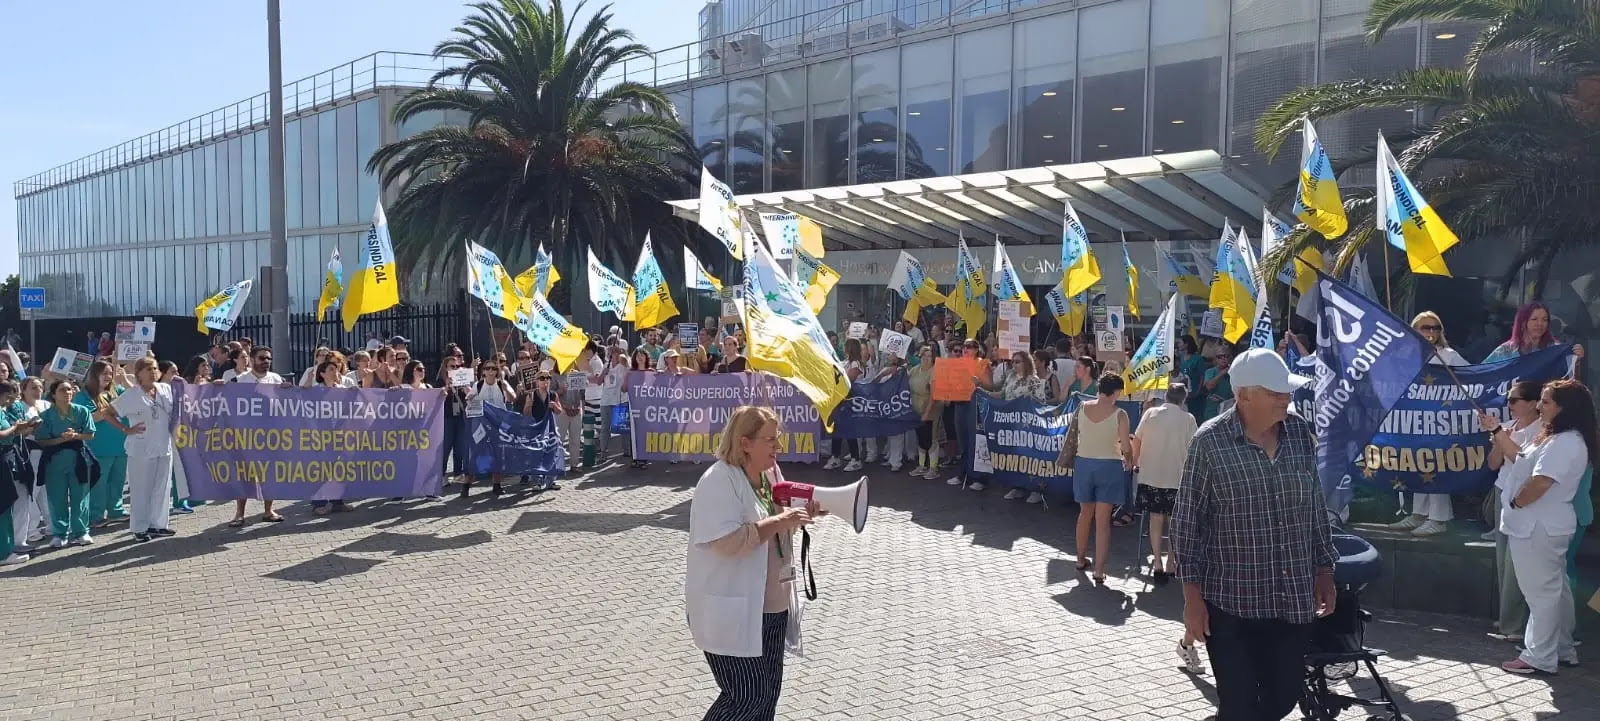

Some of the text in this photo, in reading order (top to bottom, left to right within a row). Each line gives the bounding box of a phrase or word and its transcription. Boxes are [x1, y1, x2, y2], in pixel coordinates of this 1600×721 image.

[20, 294, 43, 302] TAXI
[633, 382, 683, 400] TÉCNICO
[685, 386, 740, 400] SUPERIOR
[743, 385, 793, 401] SANTARIO
[236, 397, 263, 417] DE
[269, 396, 426, 420] INVISIBILIZACIÓN!
[645, 405, 704, 424] GRADO
[204, 422, 293, 452] TÉCNICOS
[300, 428, 431, 452] ESPECIALISTAS
[794, 432, 816, 454] YA
[997, 429, 1034, 448] GRADO
[235, 460, 270, 483] HAY
[274, 455, 396, 483] DIAGNÓSTICO
